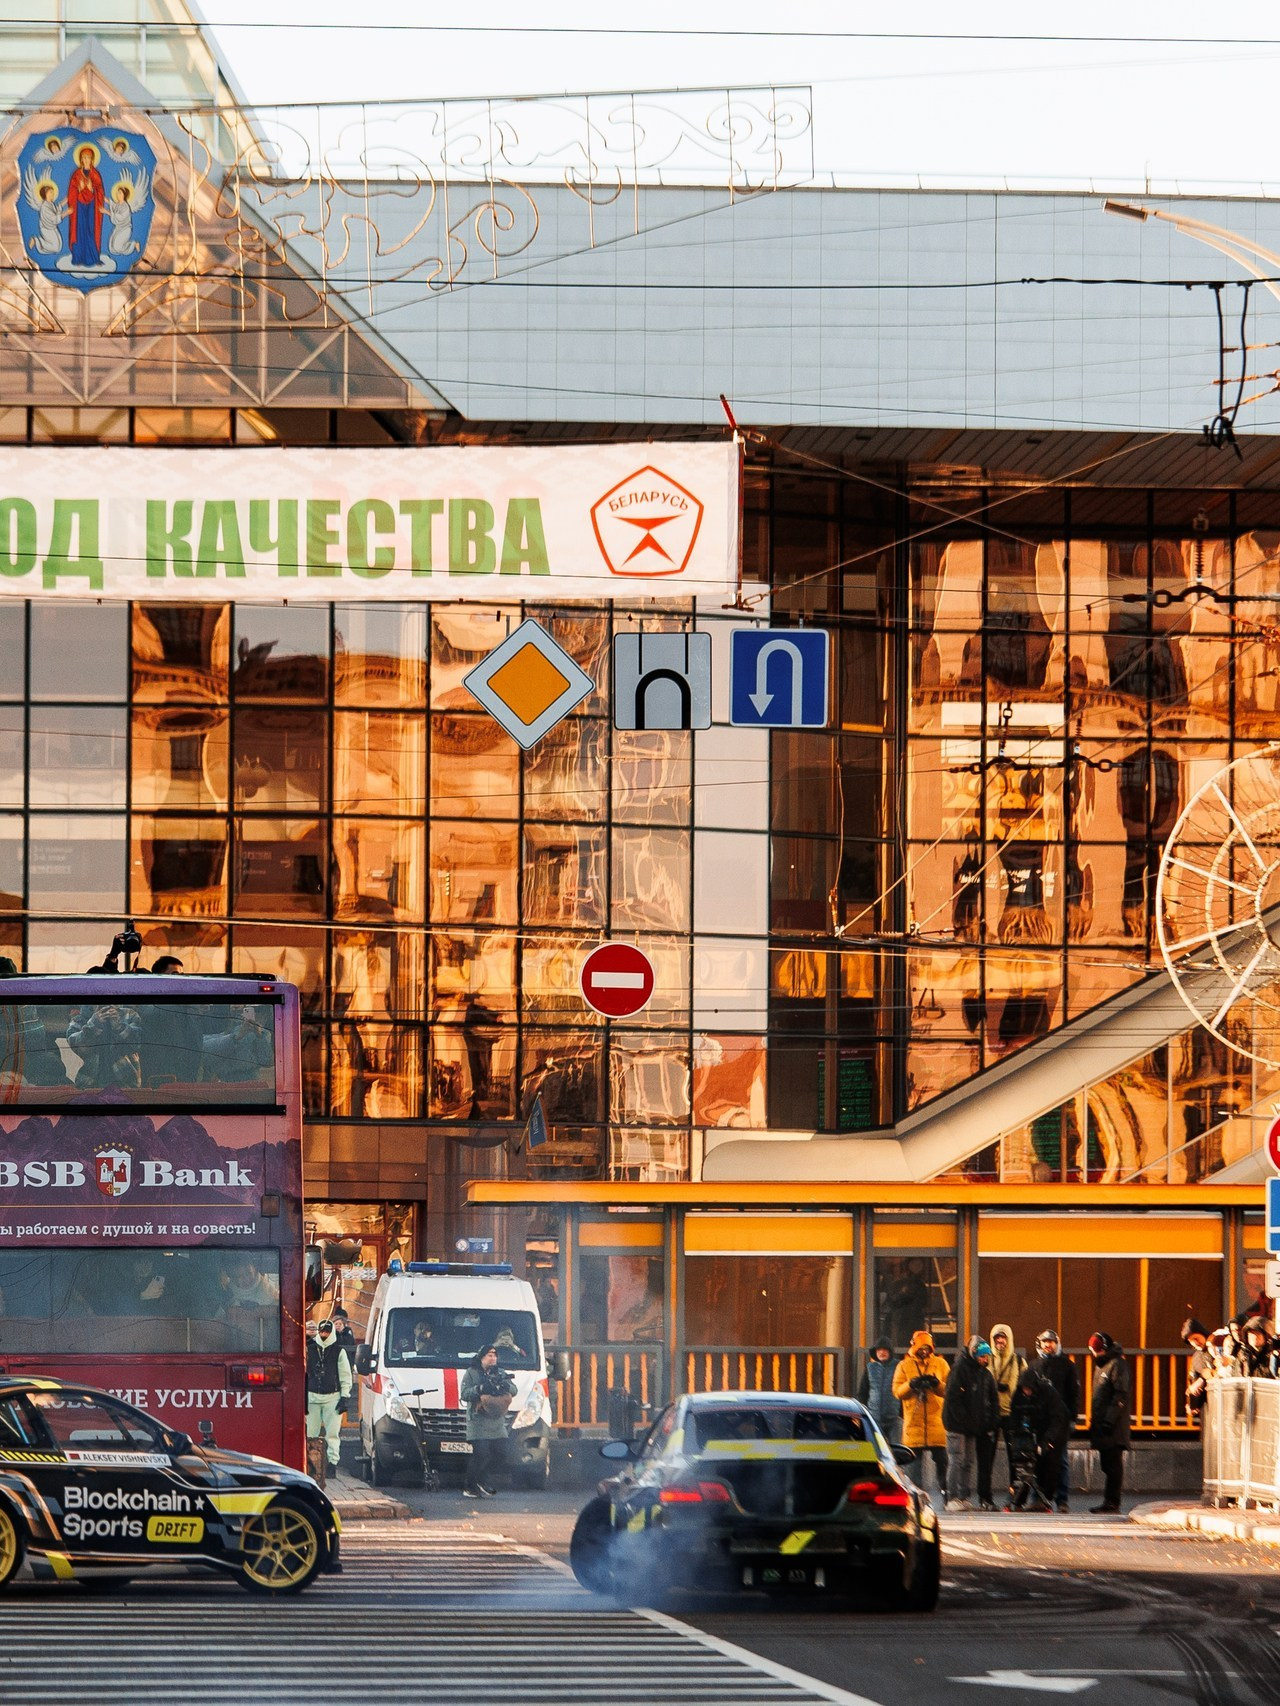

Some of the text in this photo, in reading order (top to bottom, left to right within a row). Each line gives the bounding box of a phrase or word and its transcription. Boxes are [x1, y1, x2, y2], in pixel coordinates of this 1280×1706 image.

[608, 491, 689, 512] БЕЛАРУСЬ
[146, 497, 551, 580] КАЧЕСТВА
[139, 1160, 255, 1188] Bank
[16, 1222, 87, 1237] работаем
[91, 1225, 99, 1235] с
[102, 1222, 154, 1237] душой
[157, 1225, 168, 1235] и
[171, 1225, 190, 1235] на
[193, 1222, 256, 1235] совесть!
[154, 1388, 253, 1408] УСЛУГИ
[82, 1453, 168, 1465] ALEKSEY VISHNEVSKY
[64, 1486, 191, 1512] Blockchain
[63, 1513, 197, 1540] Sports DRIFT
